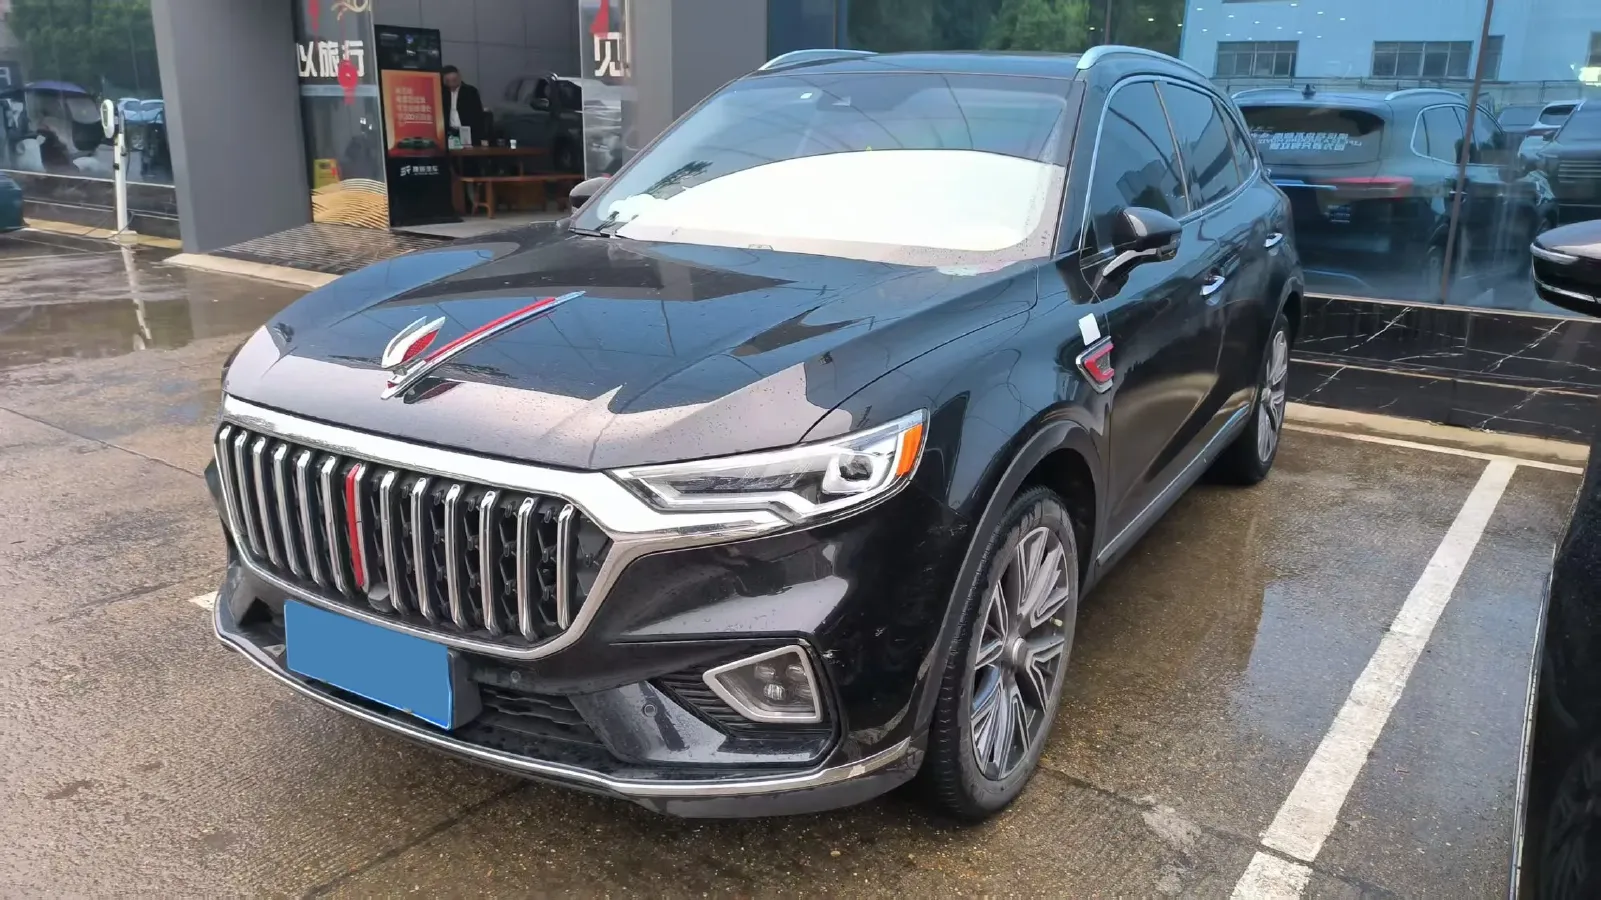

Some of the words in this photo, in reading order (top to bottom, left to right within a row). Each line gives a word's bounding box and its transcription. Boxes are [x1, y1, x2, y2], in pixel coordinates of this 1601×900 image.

[296, 40, 365, 77] 以旅行
[594, 32, 625, 77] 见
